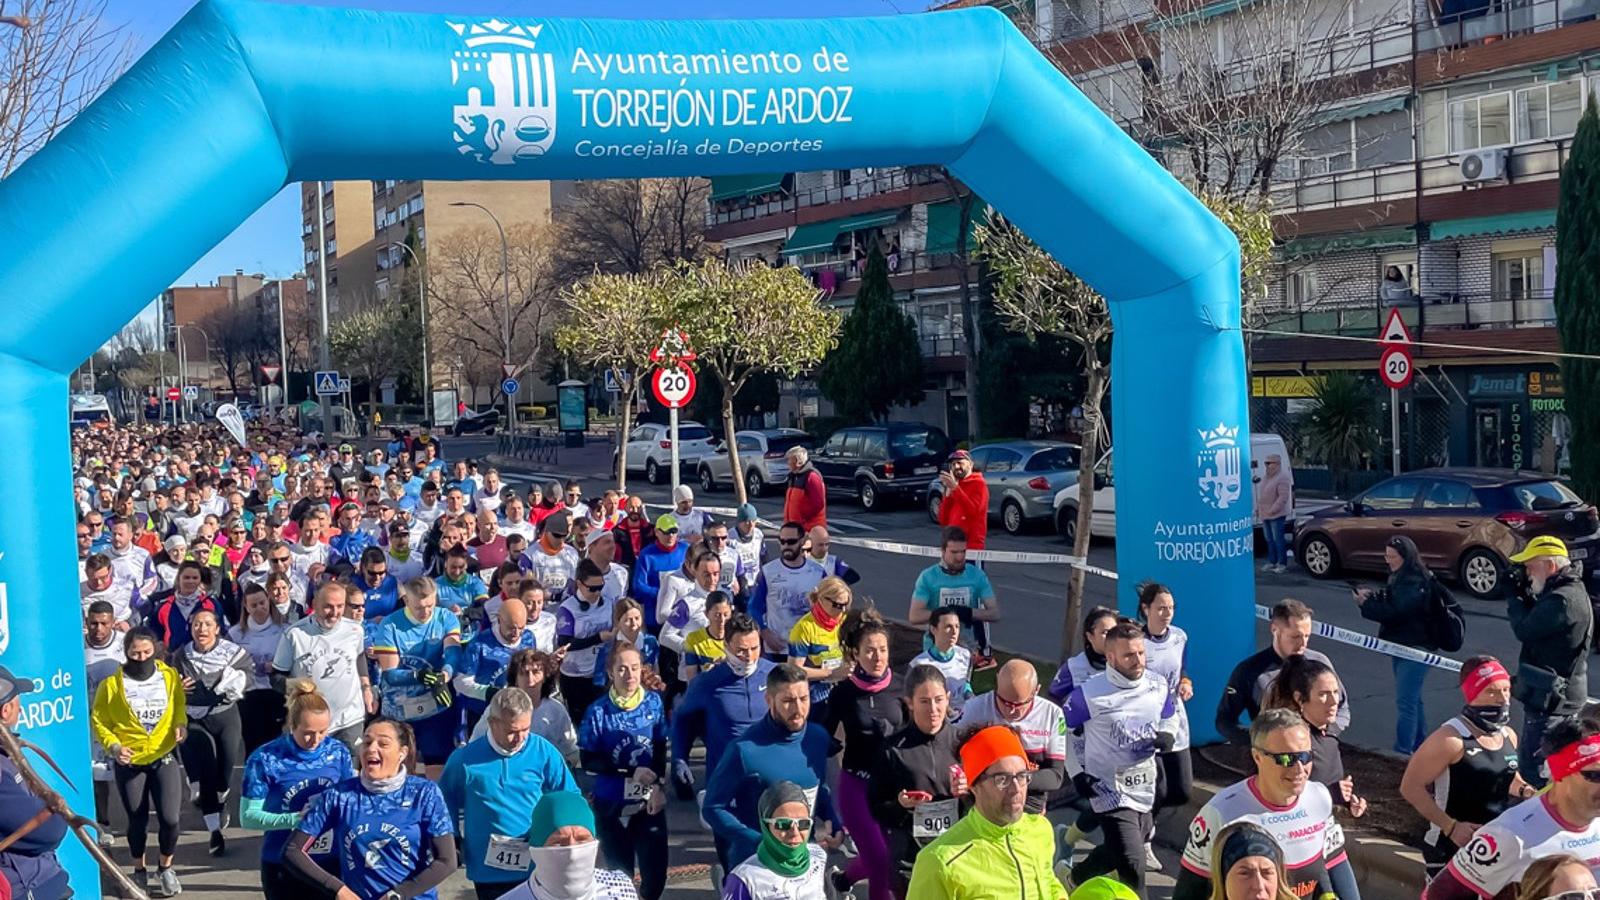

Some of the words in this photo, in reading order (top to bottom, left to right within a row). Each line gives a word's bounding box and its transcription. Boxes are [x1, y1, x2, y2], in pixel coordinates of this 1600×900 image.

[570, 46, 802, 82] Ayuntamiento
[812, 45, 849, 74] de
[572, 76, 715, 133] TORREJÓN
[722, 88, 758, 126] DE
[761, 86, 853, 126] ARDOZ
[574, 137, 689, 160] Concejalía
[695, 138, 721, 157] de
[728, 136, 823, 159] Deportes
[1389, 360, 1407, 374] 20
[662, 376, 687, 392] 20
[1469, 373, 1526, 395] Jemat
[1155, 535, 1226, 563] TORREJÓN
[1228, 537, 1242, 558] DE
[51, 668, 72, 690] de
[15, 695, 75, 731] ARDOZ
[136, 709, 162, 720] 1495
[417, 705, 424, 714] 9
[1124, 772, 1148, 787] 861
[356, 822, 370, 835] 21
[380, 822, 401, 837] WE
[924, 816, 951, 831] 909
[495, 851, 521, 866] 411
